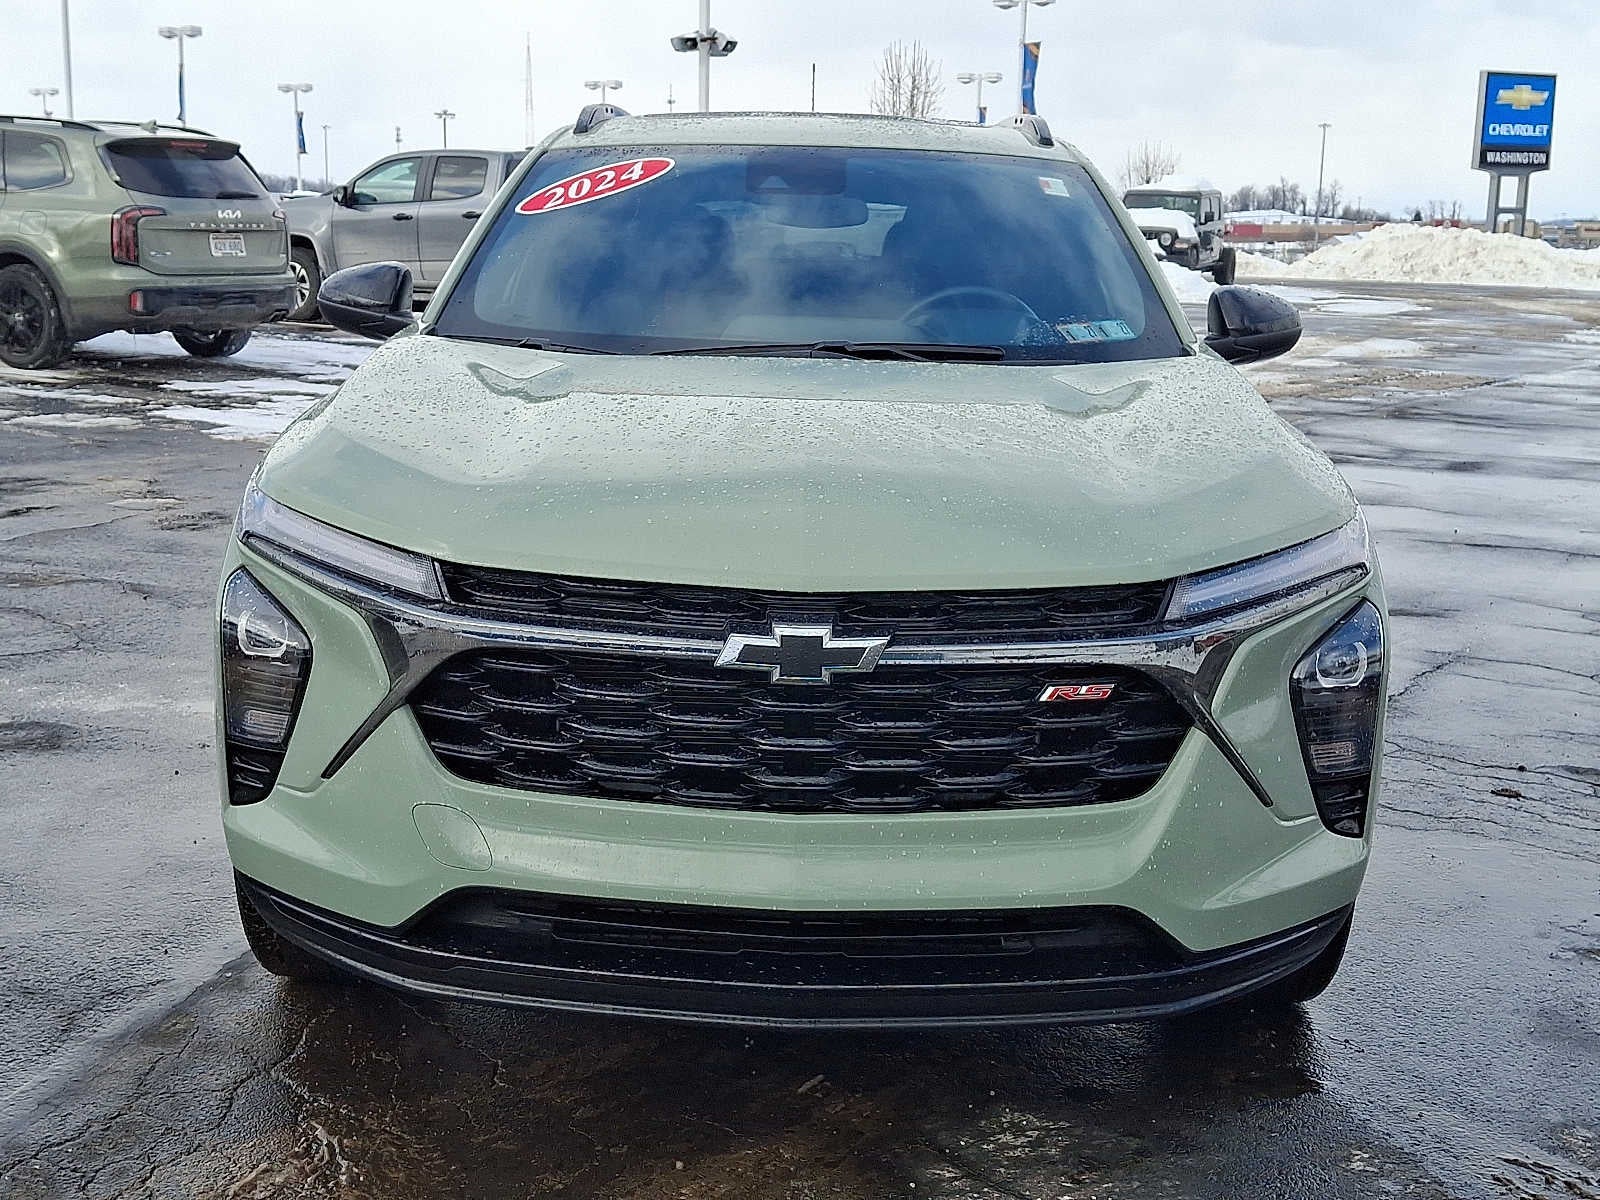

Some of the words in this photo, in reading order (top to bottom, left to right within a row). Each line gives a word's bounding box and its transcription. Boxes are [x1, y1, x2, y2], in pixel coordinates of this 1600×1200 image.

[1488, 123, 1549, 137] CHEVROLET
[1486, 151, 1547, 164] WASHINGTON
[543, 160, 645, 210] 2024
[217, 209, 242, 219] KIA
[1039, 684, 1115, 702] RS
